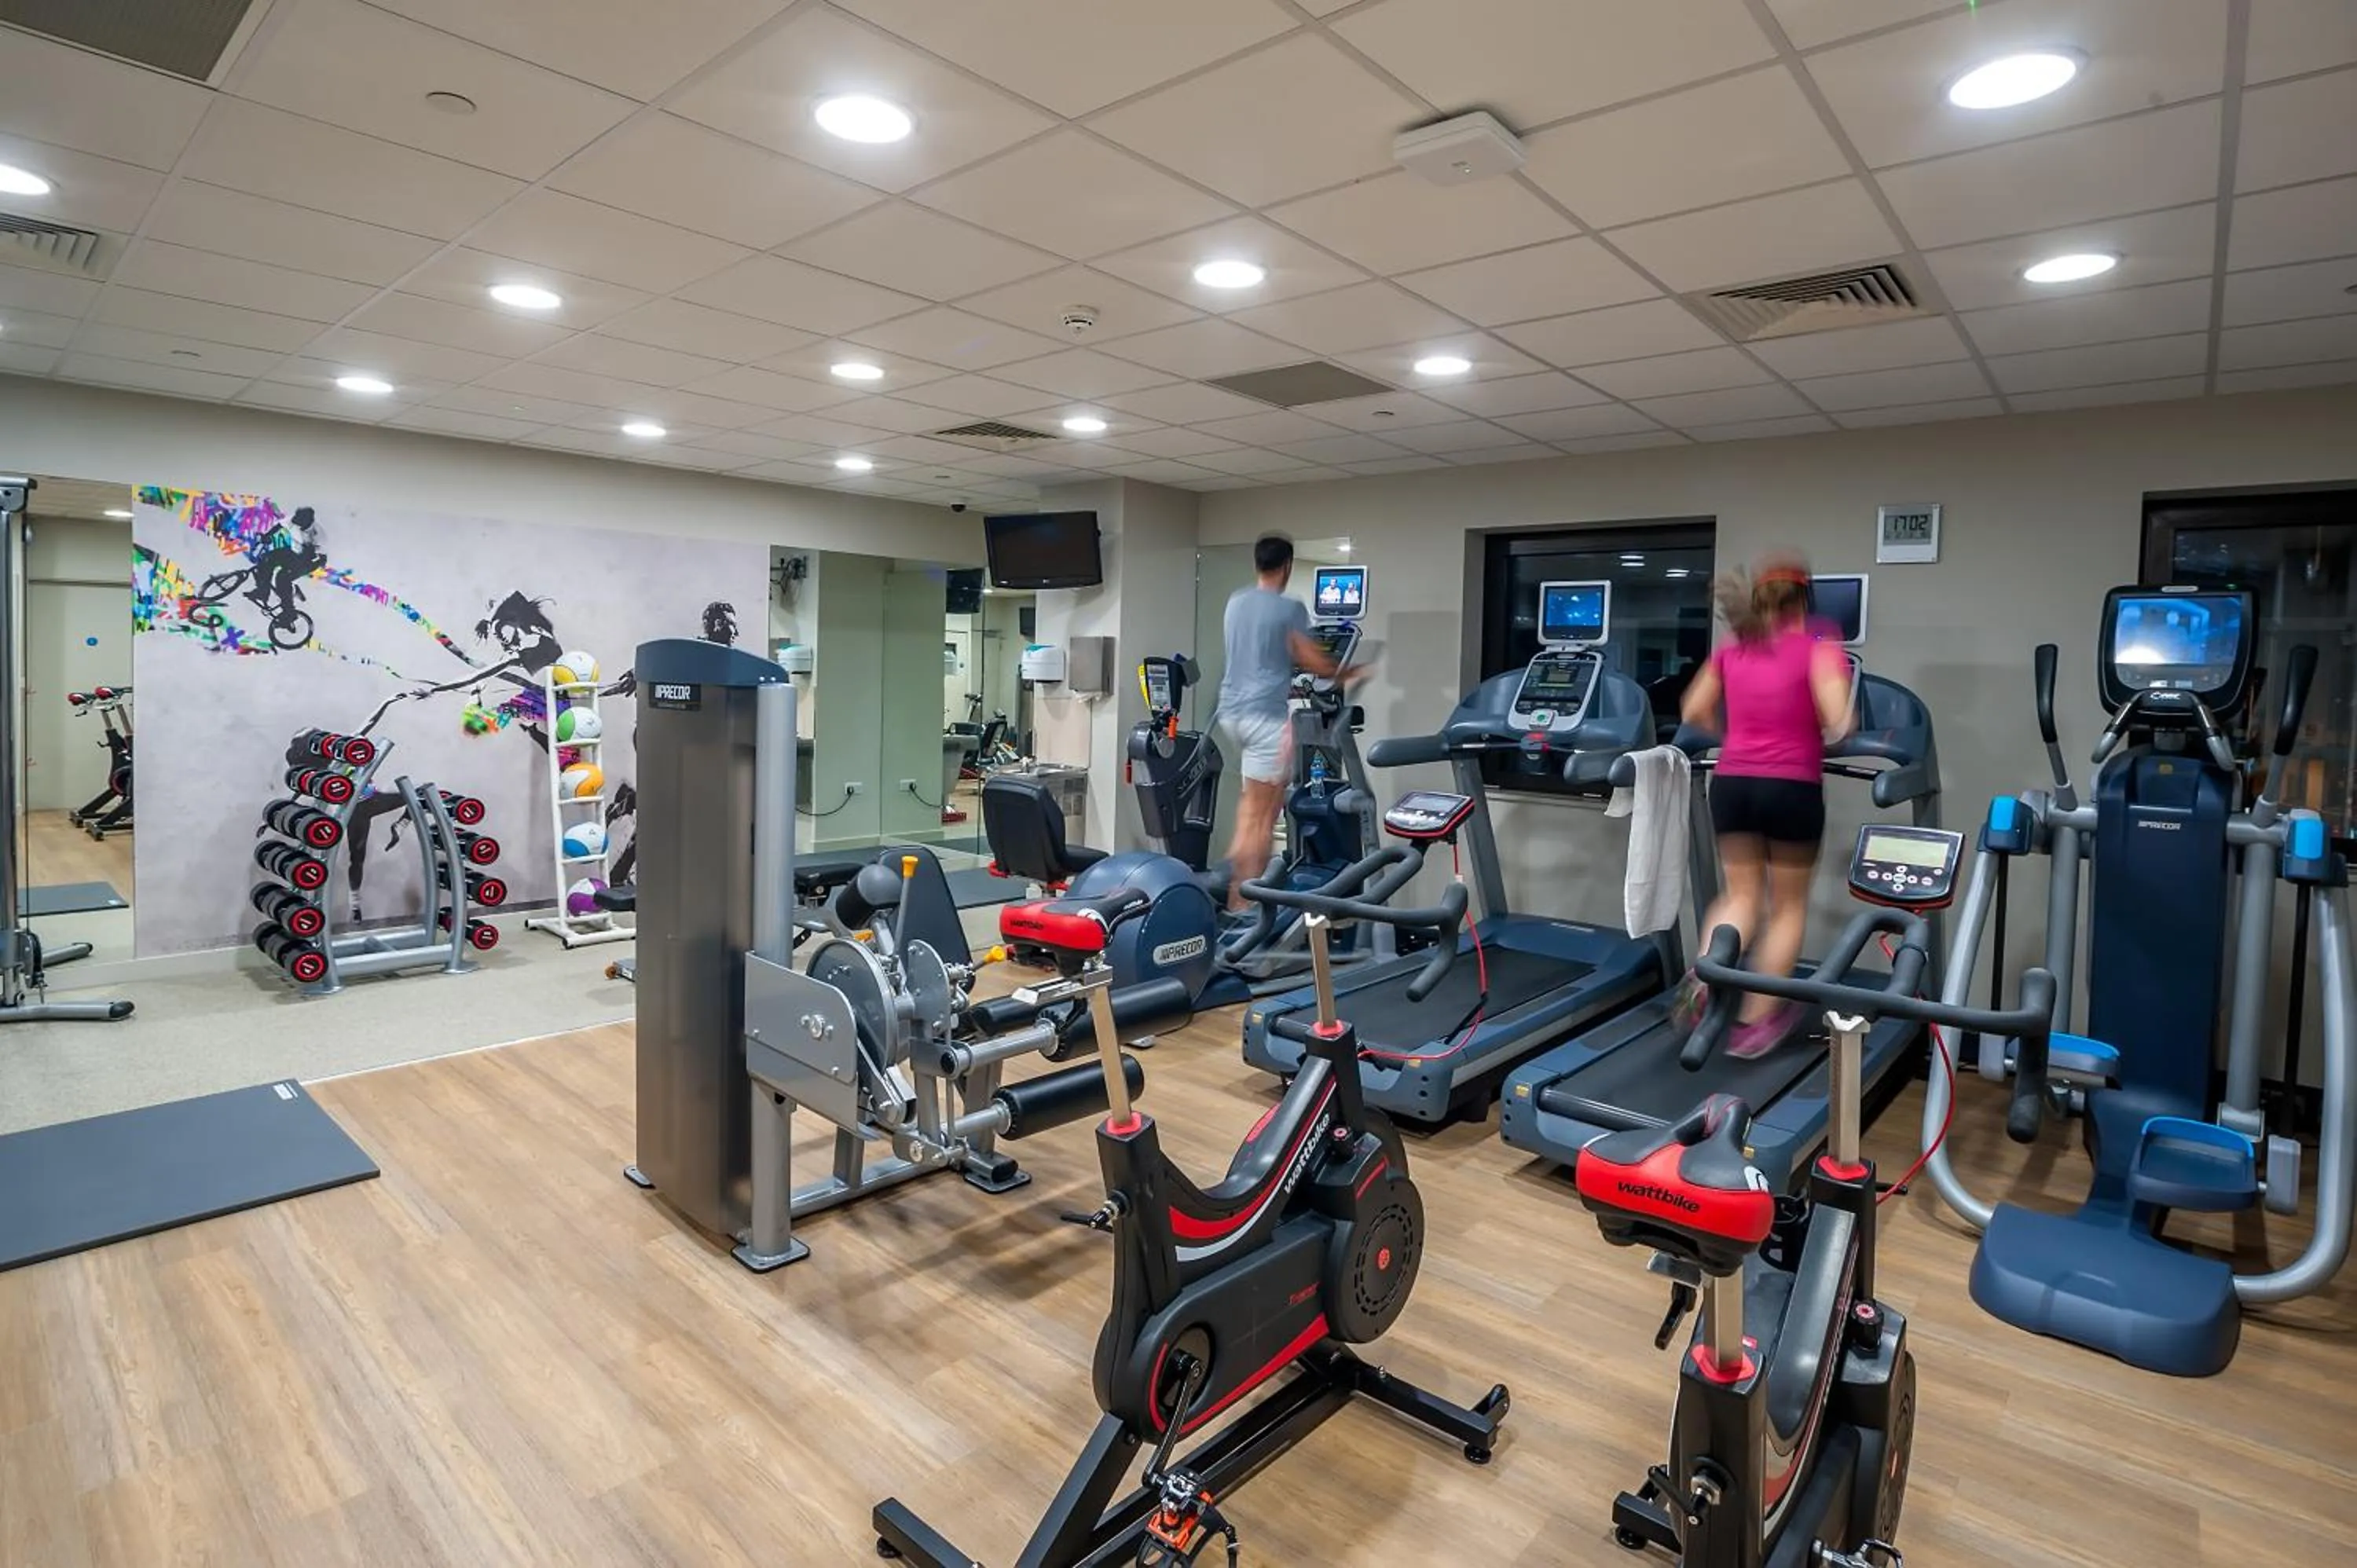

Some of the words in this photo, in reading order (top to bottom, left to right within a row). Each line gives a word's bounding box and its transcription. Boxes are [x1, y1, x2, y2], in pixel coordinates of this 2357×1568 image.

[657, 684, 691, 700] PRECOR
[1164, 939, 1203, 960] PRECOR
[1284, 1112, 1330, 1194] wattbike
[1617, 1181, 1700, 1213] wattbike
